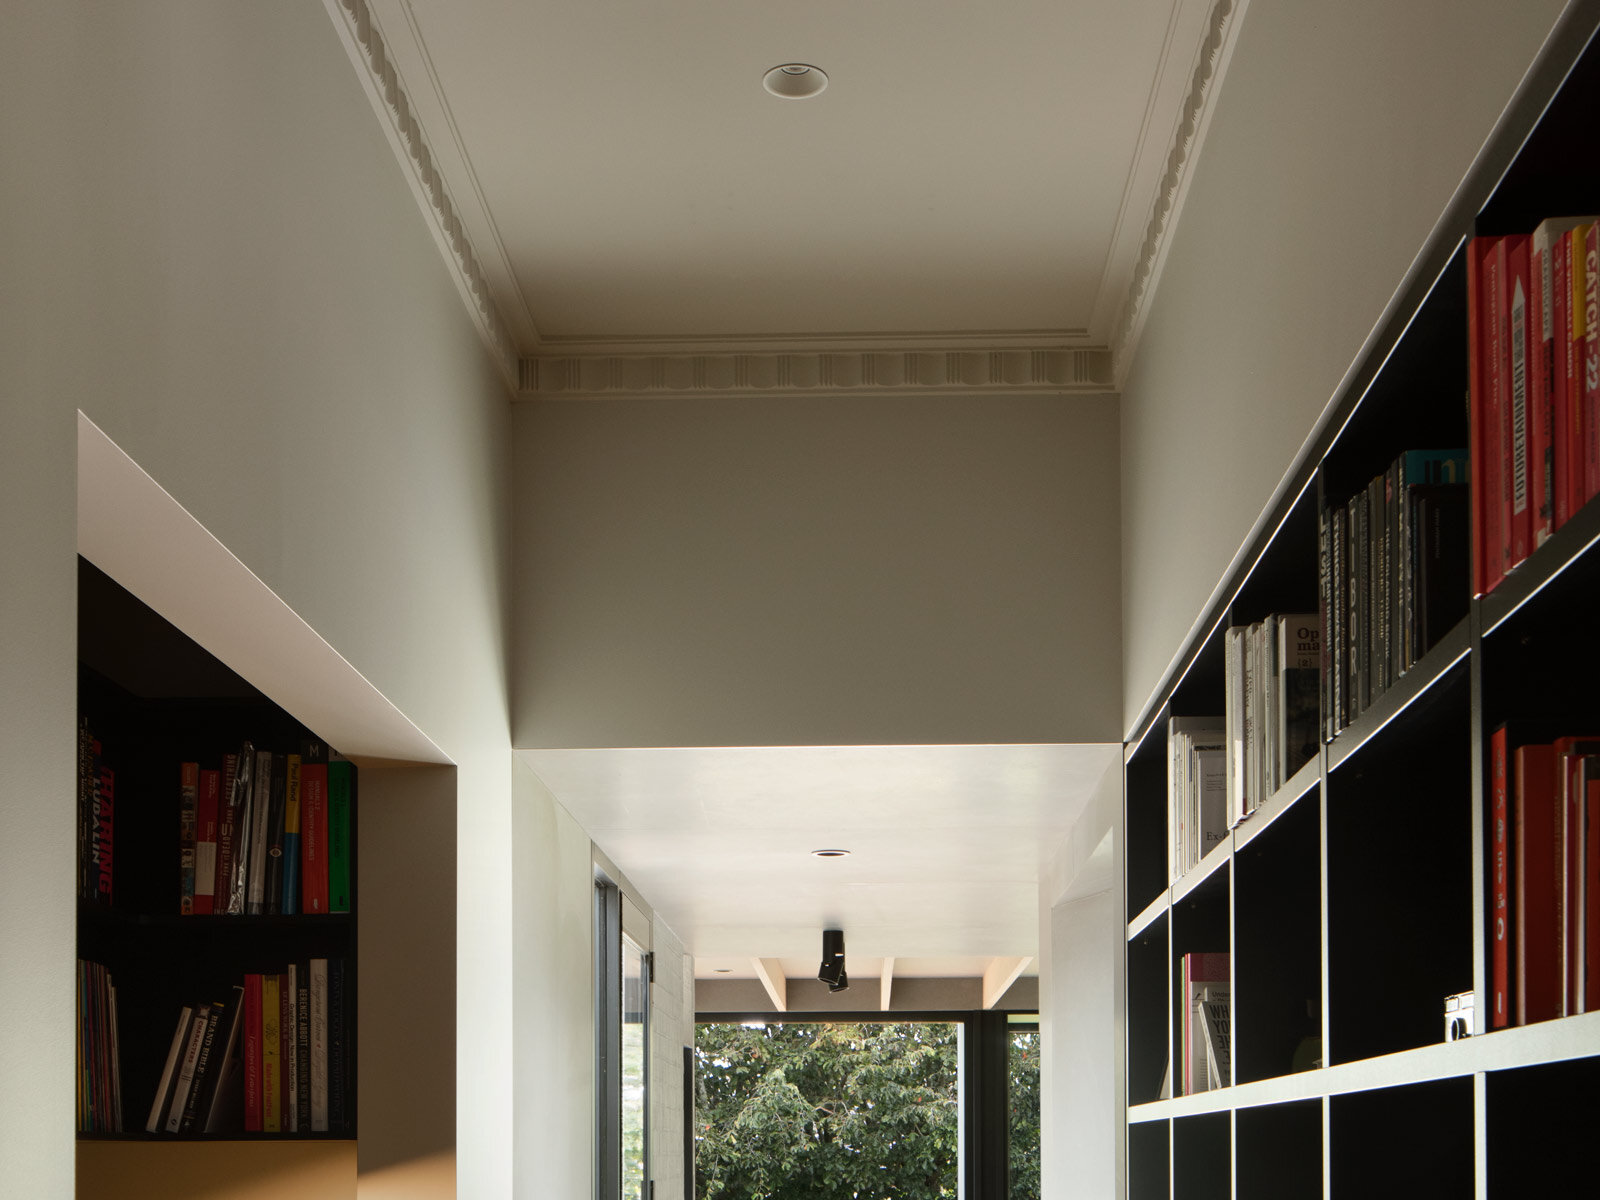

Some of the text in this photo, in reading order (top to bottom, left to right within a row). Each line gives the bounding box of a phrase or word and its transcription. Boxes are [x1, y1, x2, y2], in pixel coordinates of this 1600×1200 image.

[1585, 248, 1599, 393] CATCH-22
[289, 763, 299, 802] Paul Rand
[299, 988, 308, 1022] BERENICE
[189, 1020, 204, 1064] CHARACTERS
[299, 1022, 308, 1047] ABBOTT
